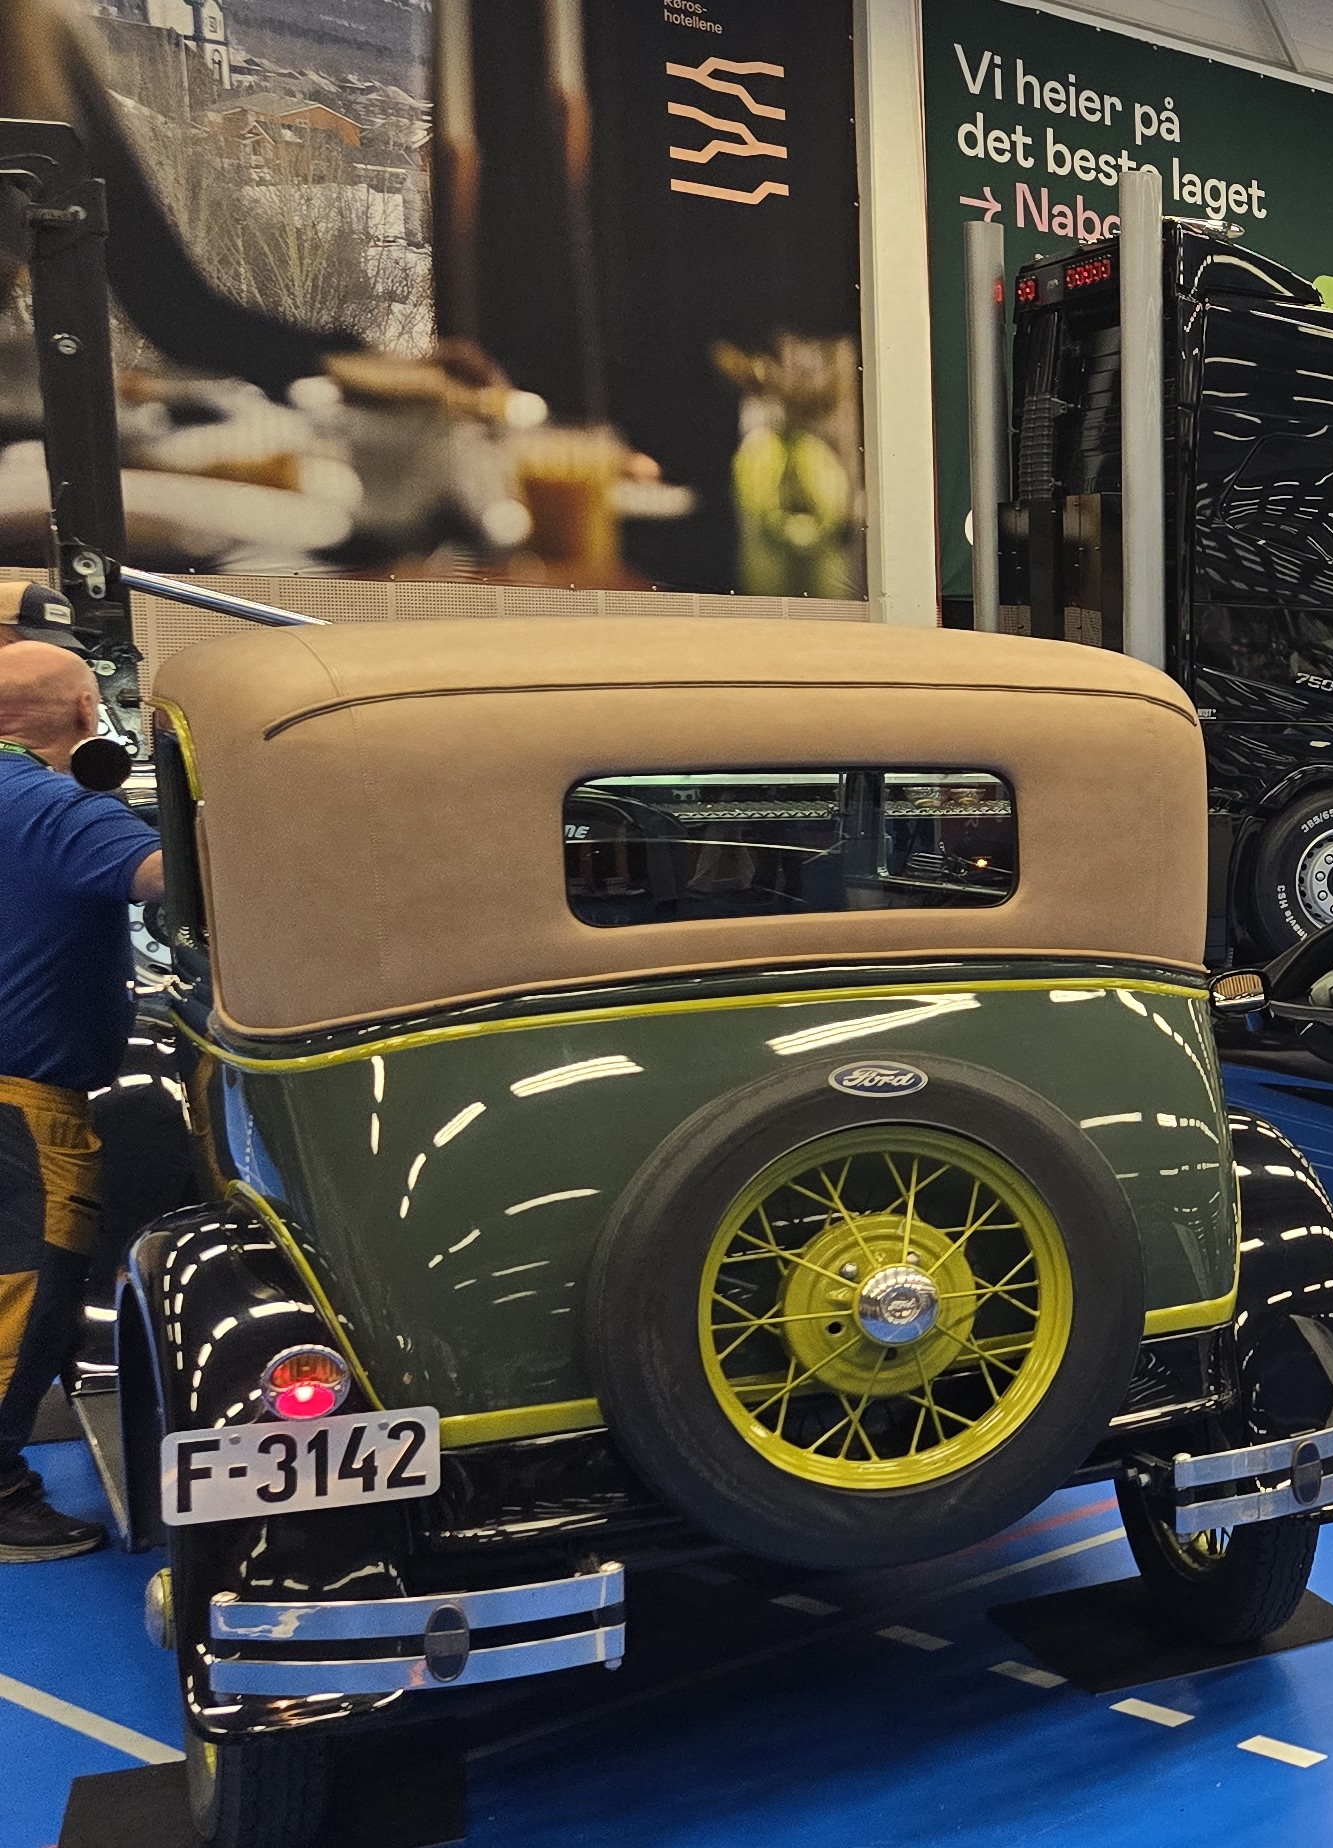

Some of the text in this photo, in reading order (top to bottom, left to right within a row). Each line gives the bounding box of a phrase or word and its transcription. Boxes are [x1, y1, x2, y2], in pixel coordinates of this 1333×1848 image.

[664, 9, 723, 34] hotellene
[954, 43, 1181, 145] Vi heier på
[957, 112, 1035, 168] det
[1172, 157, 1267, 219] laget
[842, 1067, 915, 1087] Ford
[176, 1420, 427, 1514] F-3142
